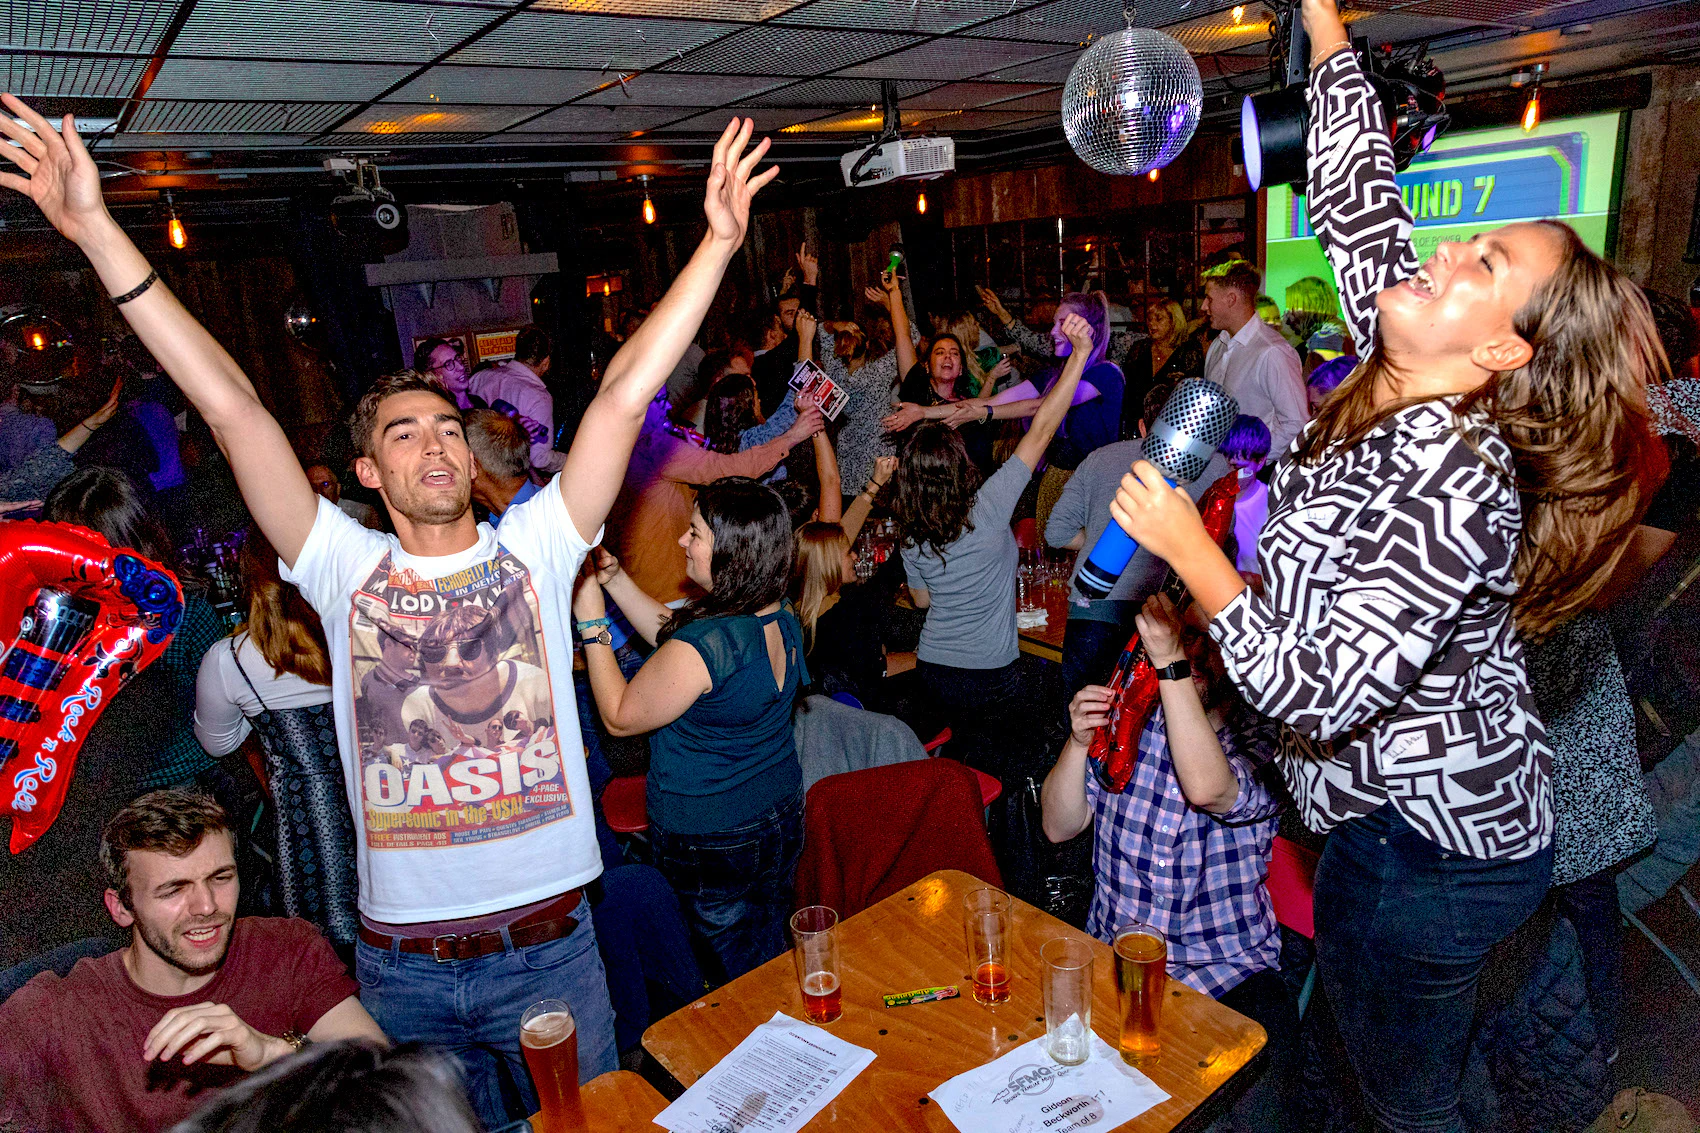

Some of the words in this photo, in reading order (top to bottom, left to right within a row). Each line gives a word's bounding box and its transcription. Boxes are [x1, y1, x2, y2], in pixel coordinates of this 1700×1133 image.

[1401, 178, 1464, 220] UND
[1472, 175, 1496, 215] 7
[1420, 236, 1431, 247] OF
[1432, 234, 1461, 247] POWER
[437, 562, 485, 594] ECHOBELLY
[369, 578, 447, 613] MLODY
[455, 586, 469, 597] IN
[57, 684, 102, 742] Rock
[11, 751, 57, 813] Roll
[364, 741, 561, 807] OASIS
[525, 792, 568, 804] EXCLUSIVE
[533, 783, 560, 793] 4-PAGE
[369, 808, 441, 831] Supersonic
[445, 808, 459, 826] in
[463, 804, 488, 825] the
[491, 796, 523, 820] USA!
[370, 833, 392, 841] FREE
[393, 832, 431, 841] INSTRUMENT
[433, 832, 447, 840] ADS
[1008, 1066, 1052, 1092] SFMQ
[1040, 1096, 1073, 1114] Gideon
[1043, 1100, 1090, 1127] Beckworth
[1055, 1121, 1081, 1133] Team
[1081, 1117, 1090, 1126] of
